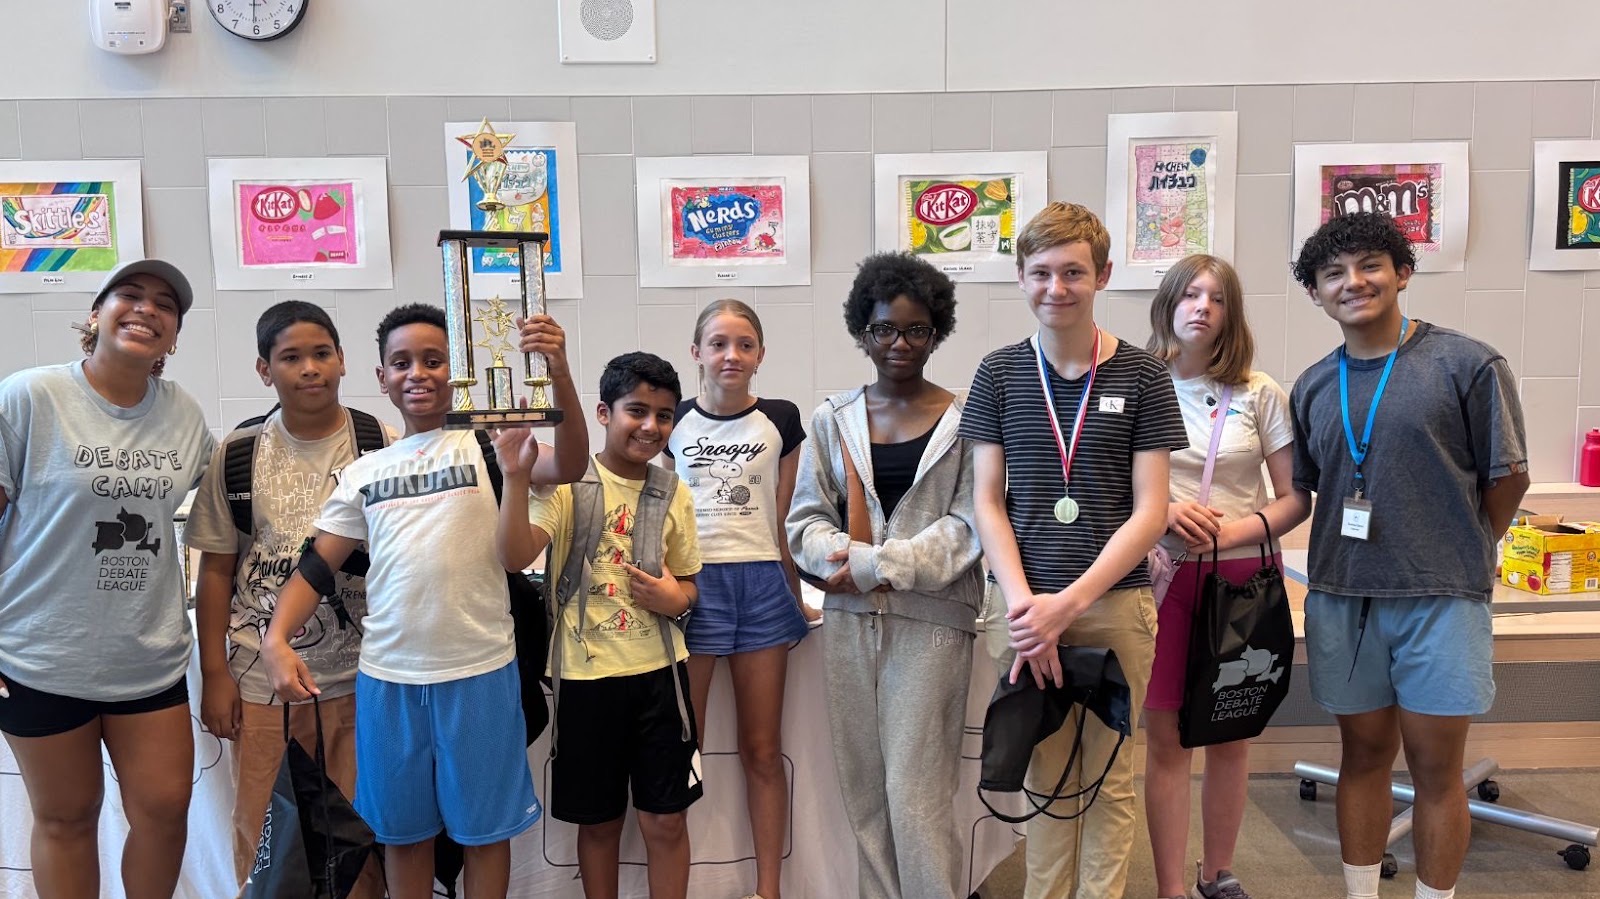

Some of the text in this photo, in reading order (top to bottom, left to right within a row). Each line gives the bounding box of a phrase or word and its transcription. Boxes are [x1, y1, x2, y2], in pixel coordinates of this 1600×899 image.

[217, 4, 224, 13] 8
[287, 5, 294, 14] 4
[232, 19, 239, 29] 7
[253, 25, 260, 35] 6
[273, 20, 280, 29] 5
[14, 207, 100, 235] Skittles
[682, 437, 767, 461] Snoopy
[74, 445, 182, 471] DEBATE
[367, 449, 474, 502] JORDAN
[92, 476, 173, 500] CAMP
[101, 556, 150, 567] BOSTON
[99, 567, 148, 579] DEBATE
[97, 580, 146, 591] LEAGUE
[1218, 684, 1269, 700] BOSTON
[1214, 695, 1264, 711] DEBATE
[1211, 705, 1260, 721] LEAGUE
